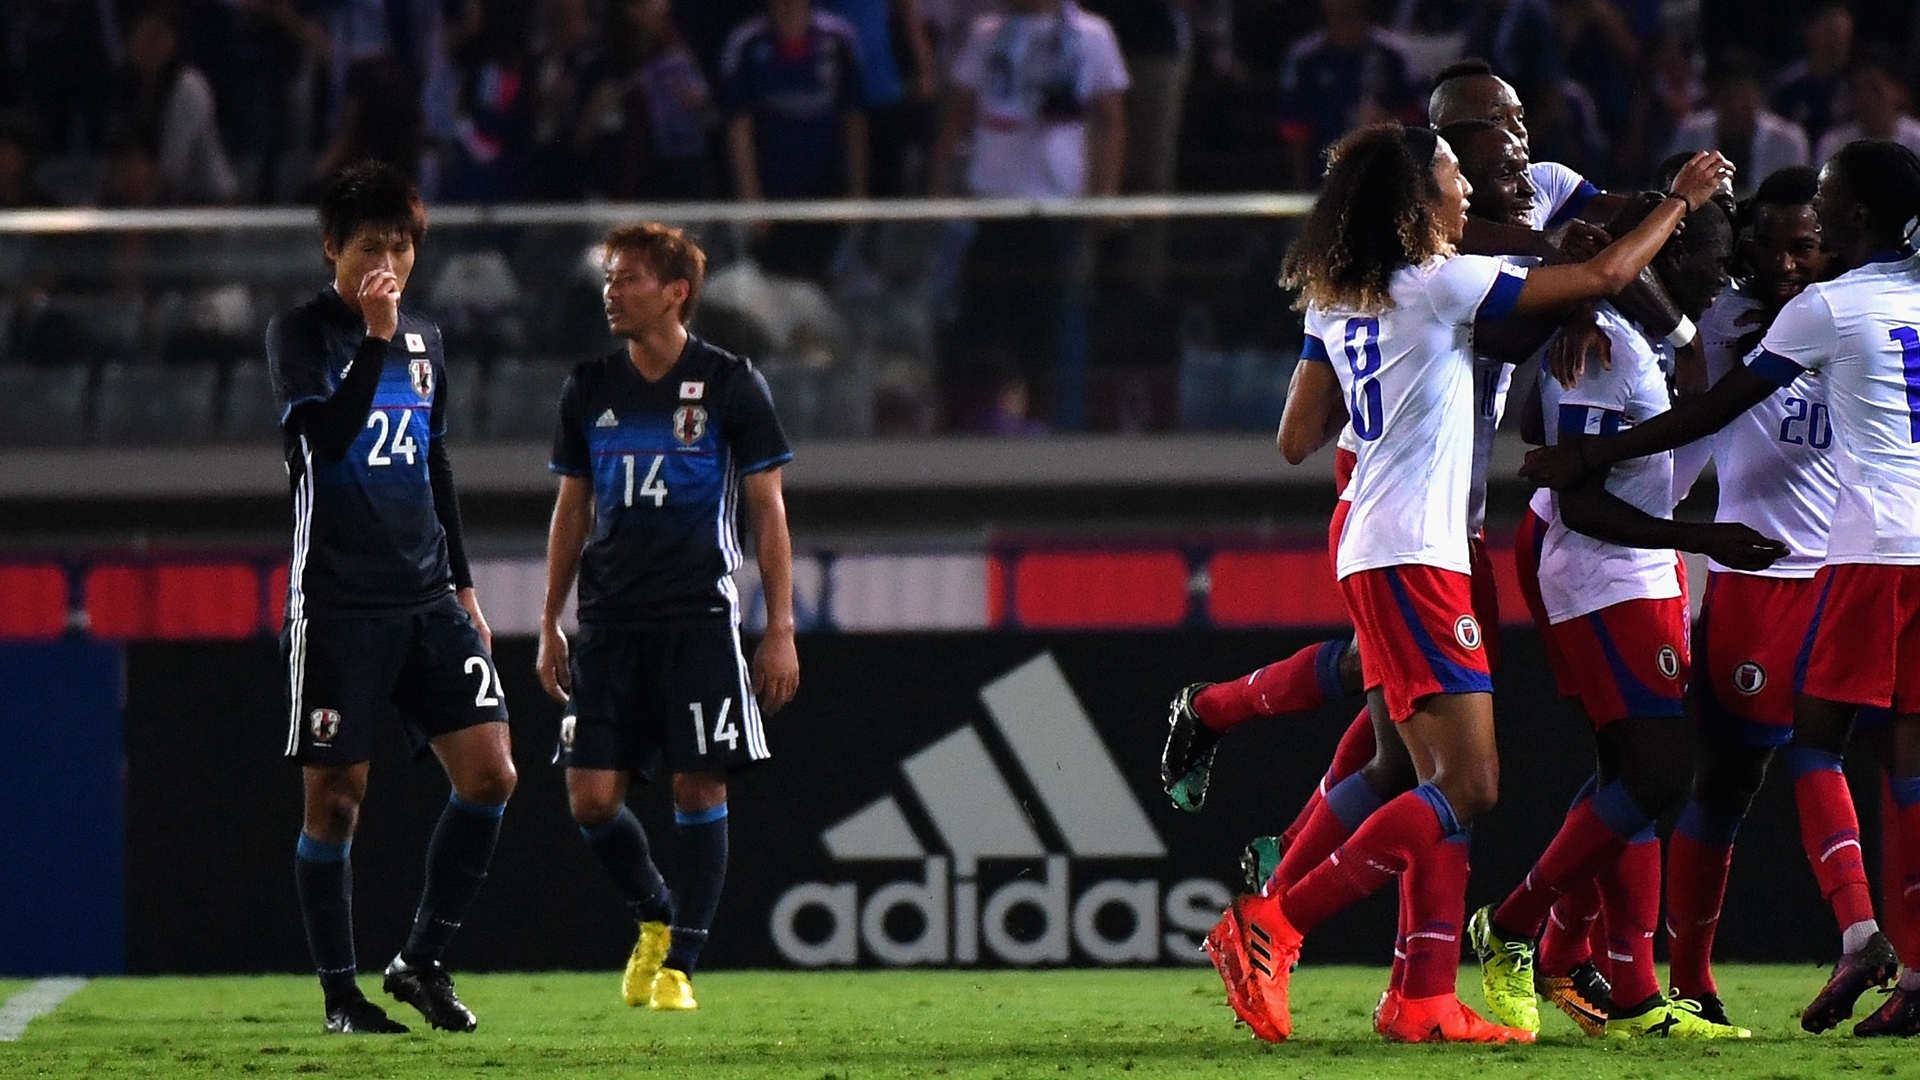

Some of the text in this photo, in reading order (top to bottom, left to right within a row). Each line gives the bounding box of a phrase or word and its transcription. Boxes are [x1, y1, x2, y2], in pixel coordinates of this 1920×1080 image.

[1344, 317, 1383, 441] 8
[367, 409, 417, 466] 24
[1779, 397, 1833, 449] 20
[622, 454, 668, 507] 14
[689, 697, 740, 755] 14
[771, 855, 1232, 966] adidas
